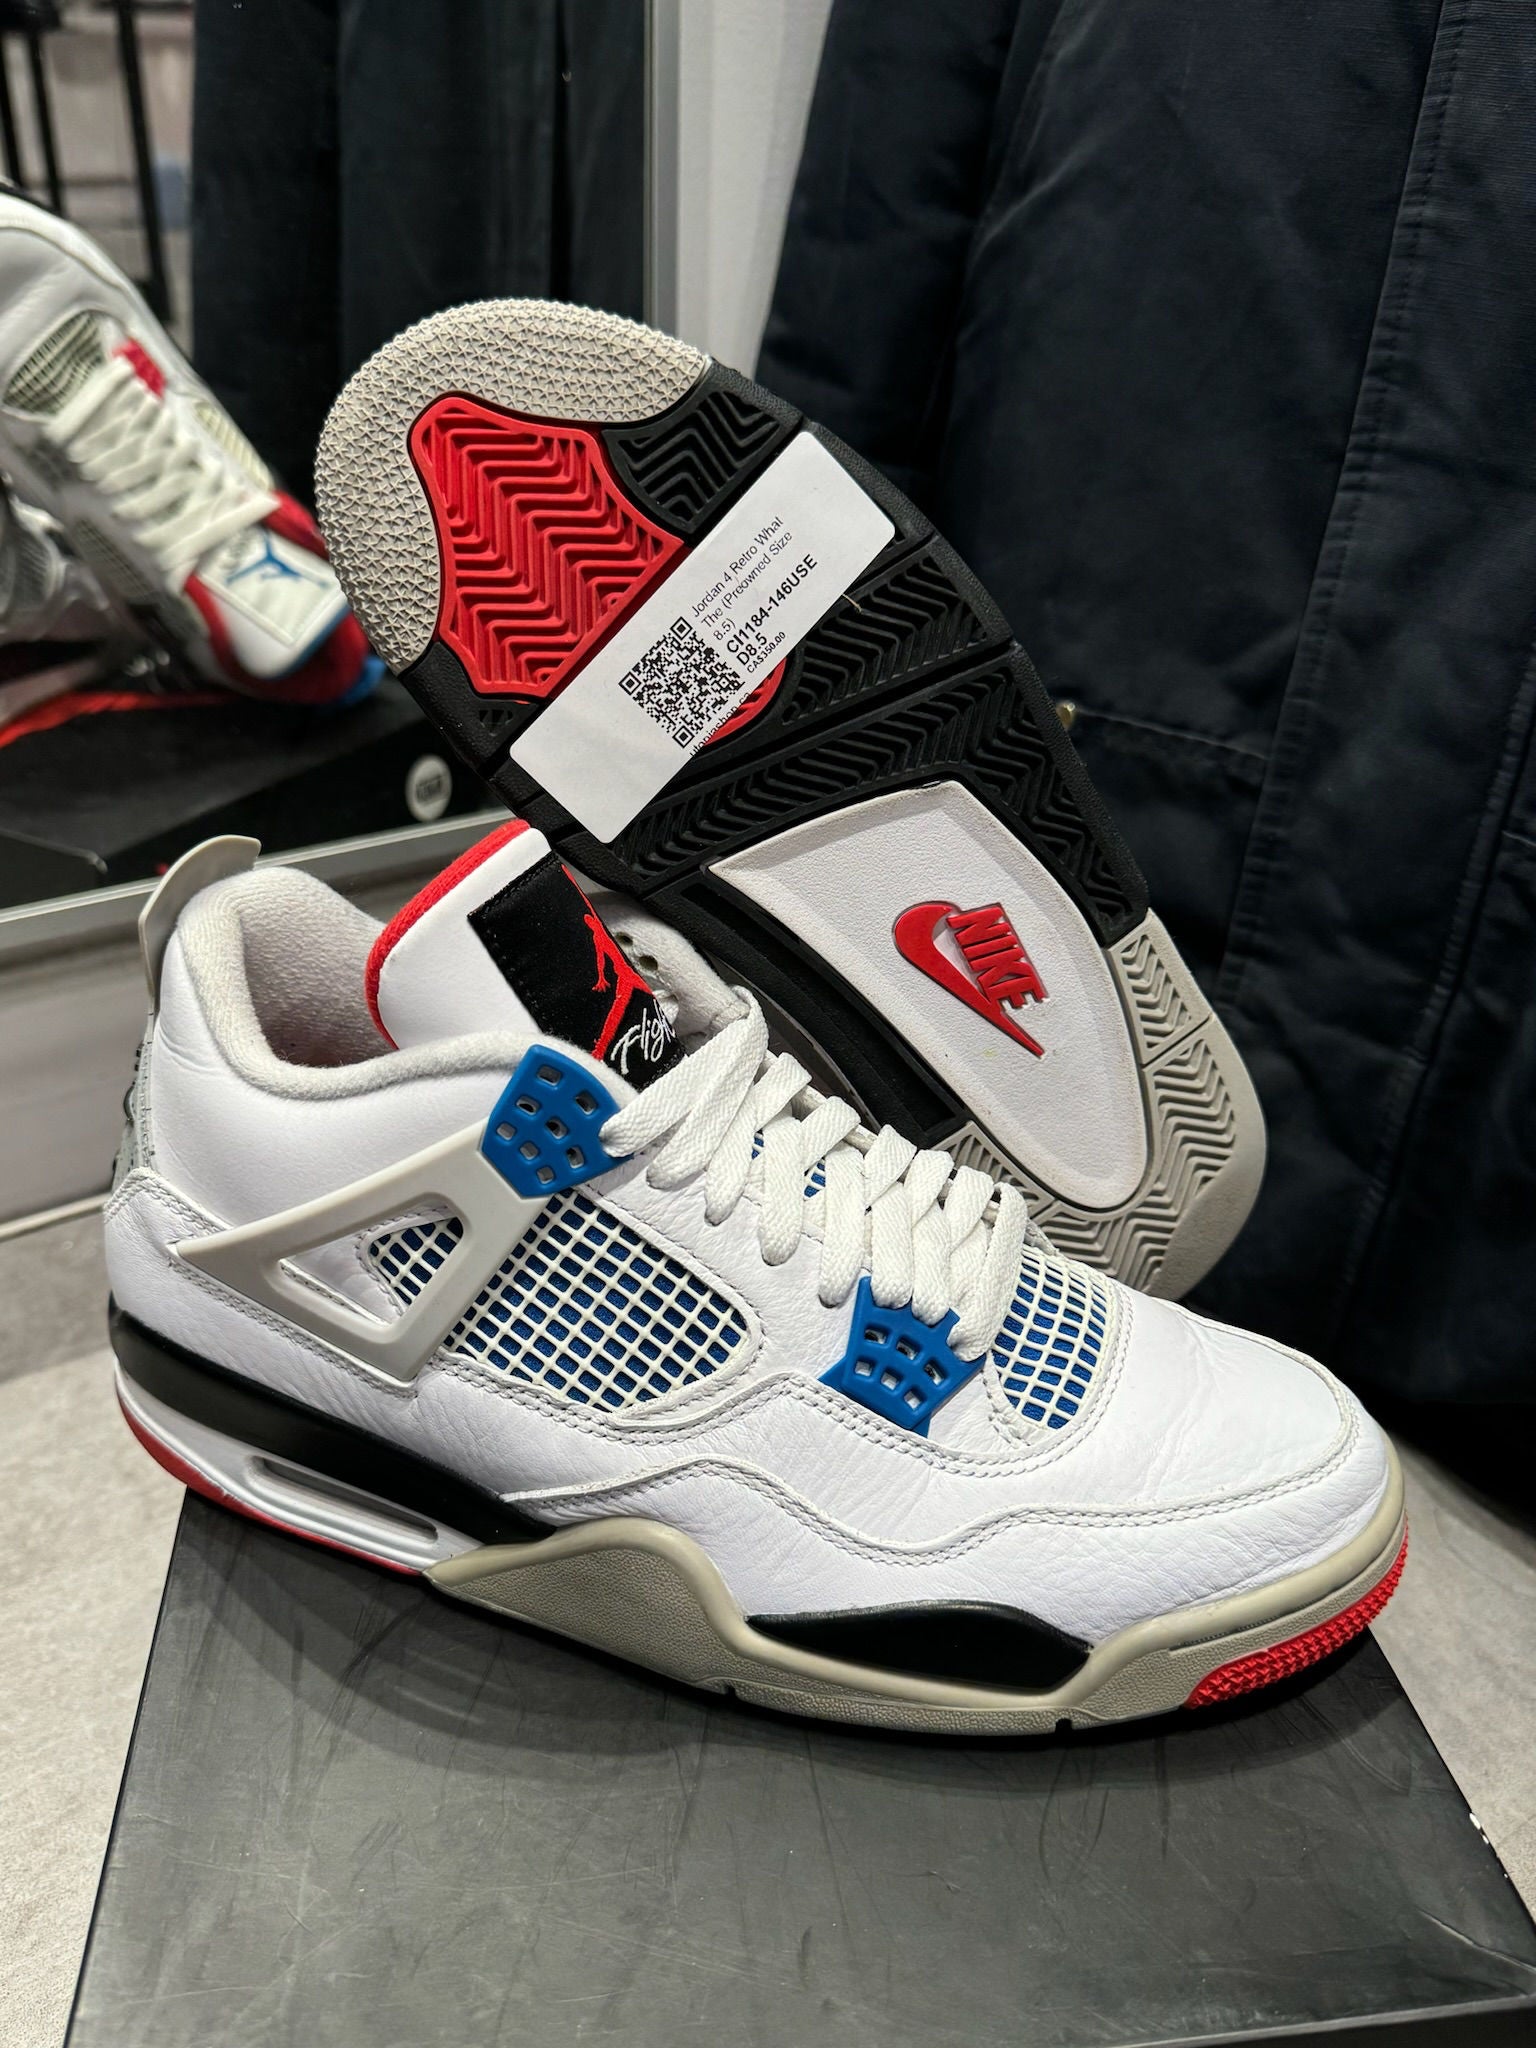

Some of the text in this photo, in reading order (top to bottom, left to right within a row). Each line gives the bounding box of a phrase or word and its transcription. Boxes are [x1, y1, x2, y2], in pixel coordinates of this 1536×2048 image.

[692, 517, 783, 617] Jordan 4 Retro What
[701, 532, 792, 628] The (Preowned Size
[726, 554, 818, 653] CI1184-146USE
[713, 618, 736, 641] 8.5)
[736, 632, 767, 666] D8.5
[747, 631, 786, 673] CA$350.00
[946, 905, 1046, 1009] NIKE
